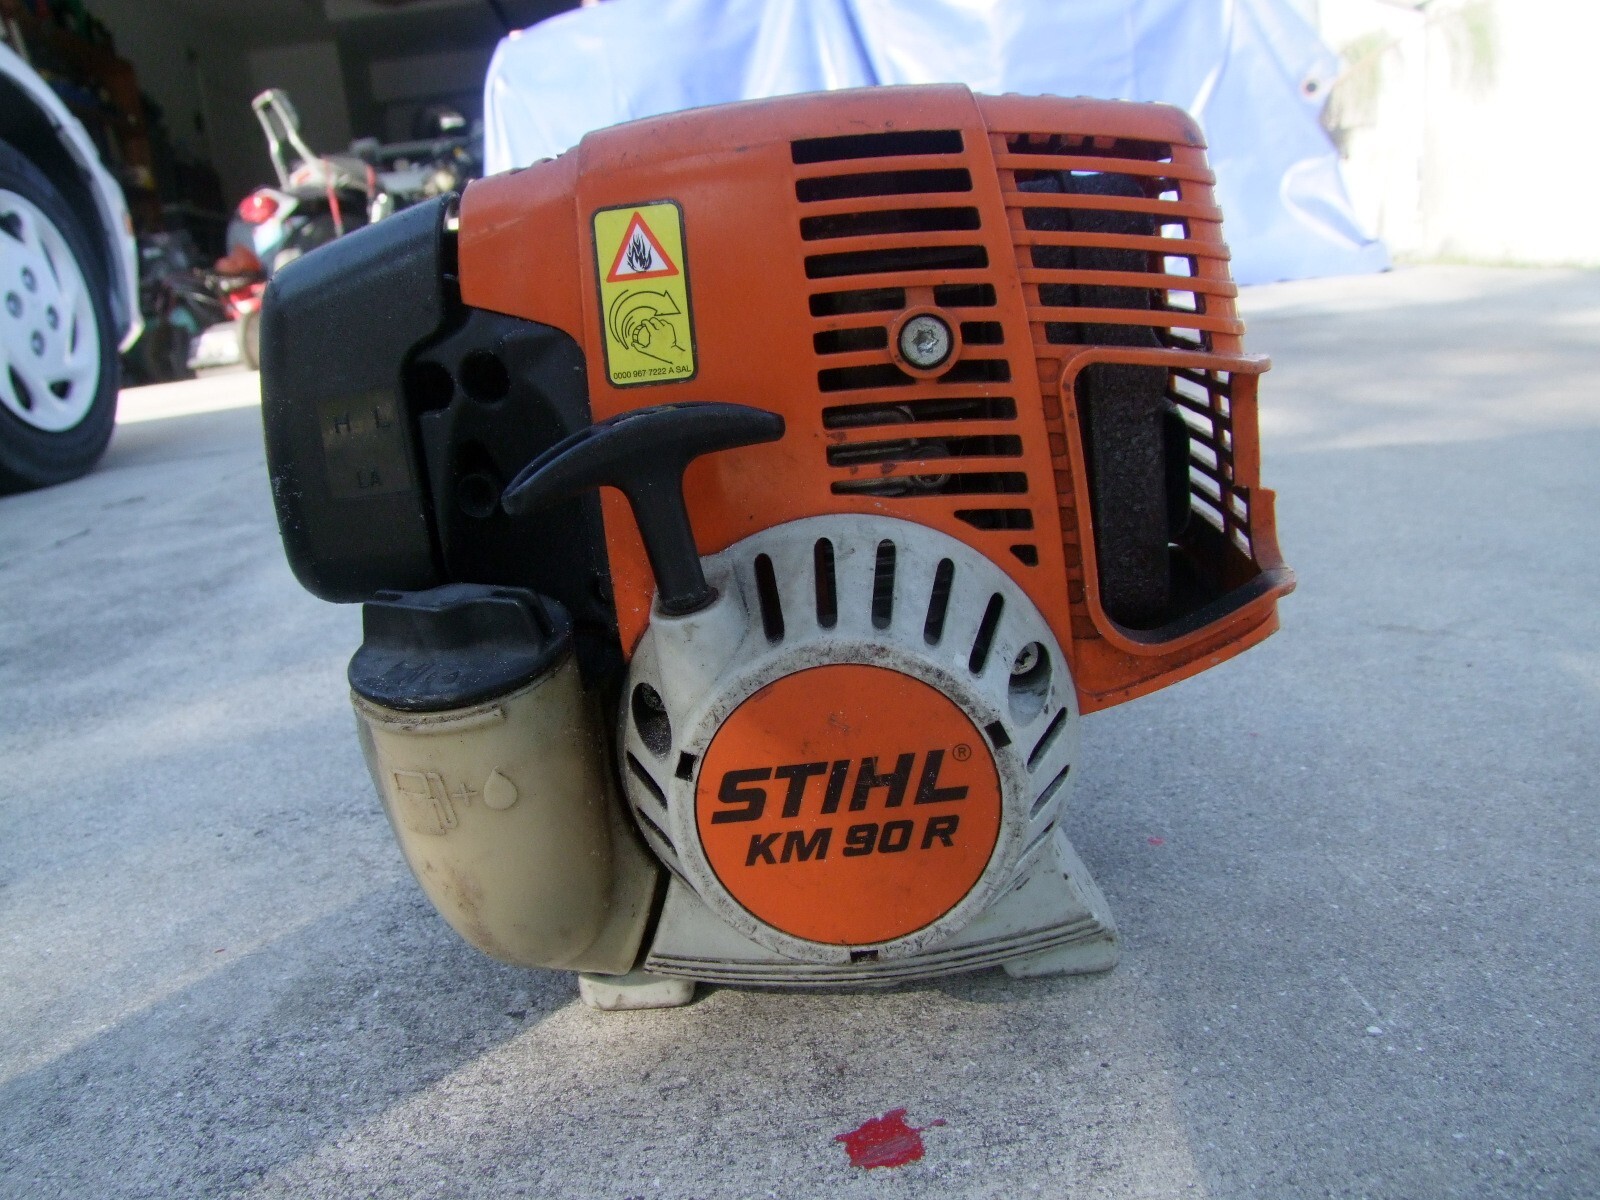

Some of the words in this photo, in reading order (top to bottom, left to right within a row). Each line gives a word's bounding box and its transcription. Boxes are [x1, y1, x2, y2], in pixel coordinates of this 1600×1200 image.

[613, 372, 631, 380] 0000
[633, 369, 646, 378] 967
[649, 367, 666, 376] 7222
[676, 365, 691, 373] SAL
[334, 412, 352, 433] H
[710, 749, 970, 825] STIHL
[744, 827, 833, 867] KM
[842, 819, 914, 858] 90
[920, 814, 960, 850] R
